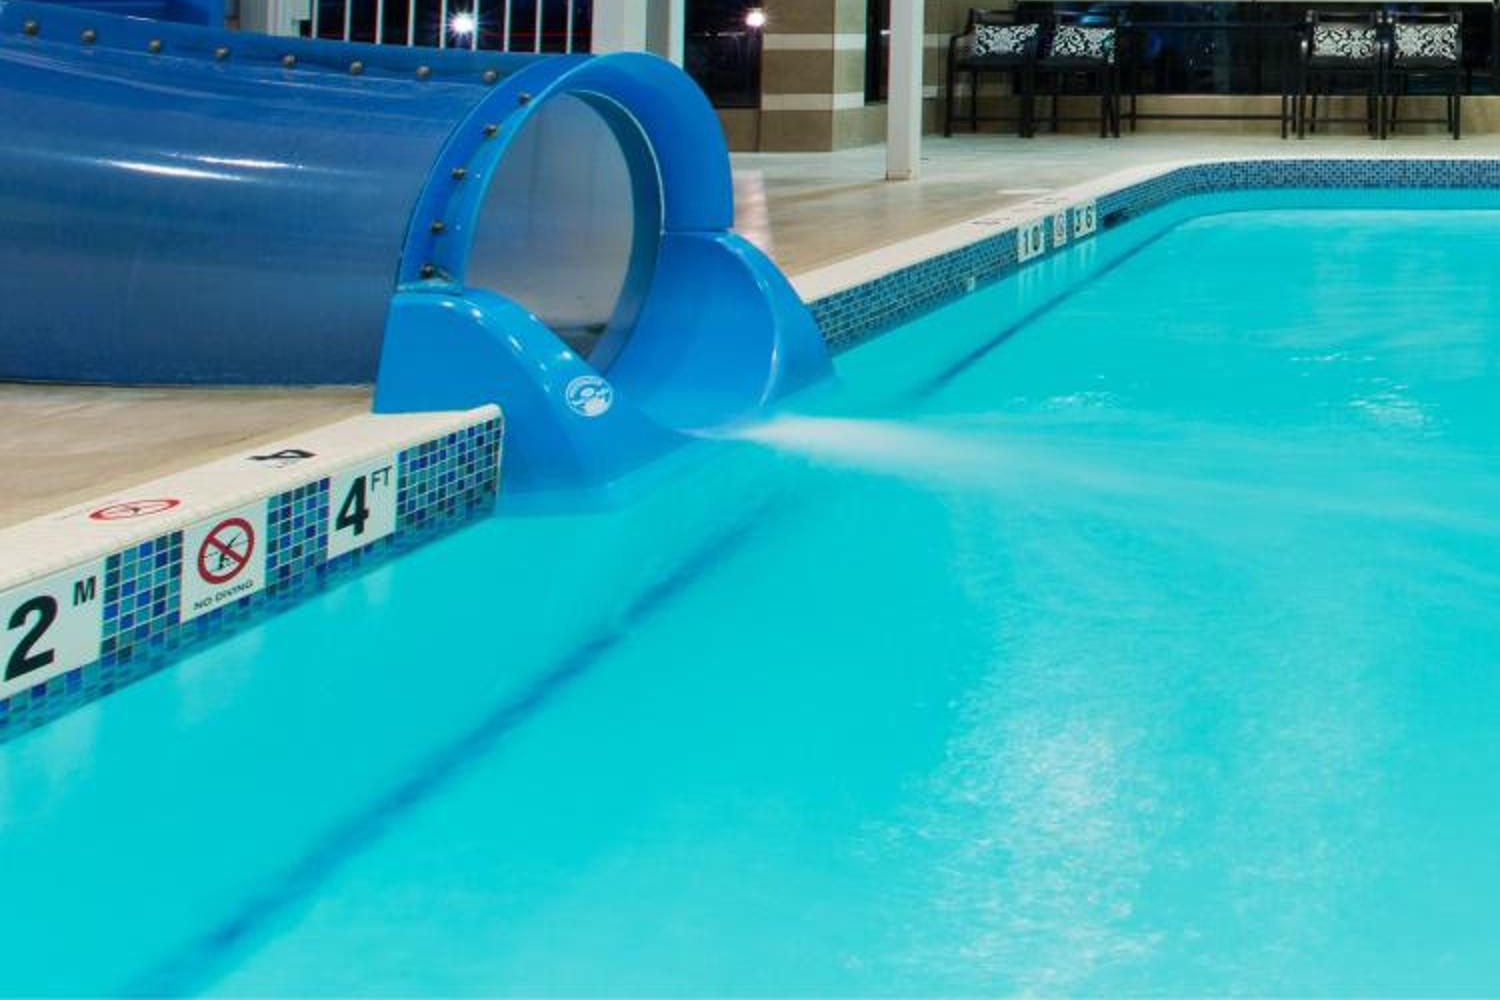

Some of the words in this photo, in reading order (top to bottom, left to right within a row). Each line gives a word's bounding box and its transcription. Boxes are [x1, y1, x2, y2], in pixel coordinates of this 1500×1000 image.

[335, 475, 369, 537] 4
[371, 464, 393, 492] FT
[3, 595, 58, 682] 2
[73, 575, 97, 607] M
[193, 597, 213, 610] NO
[215, 579, 254, 603] DIVING
